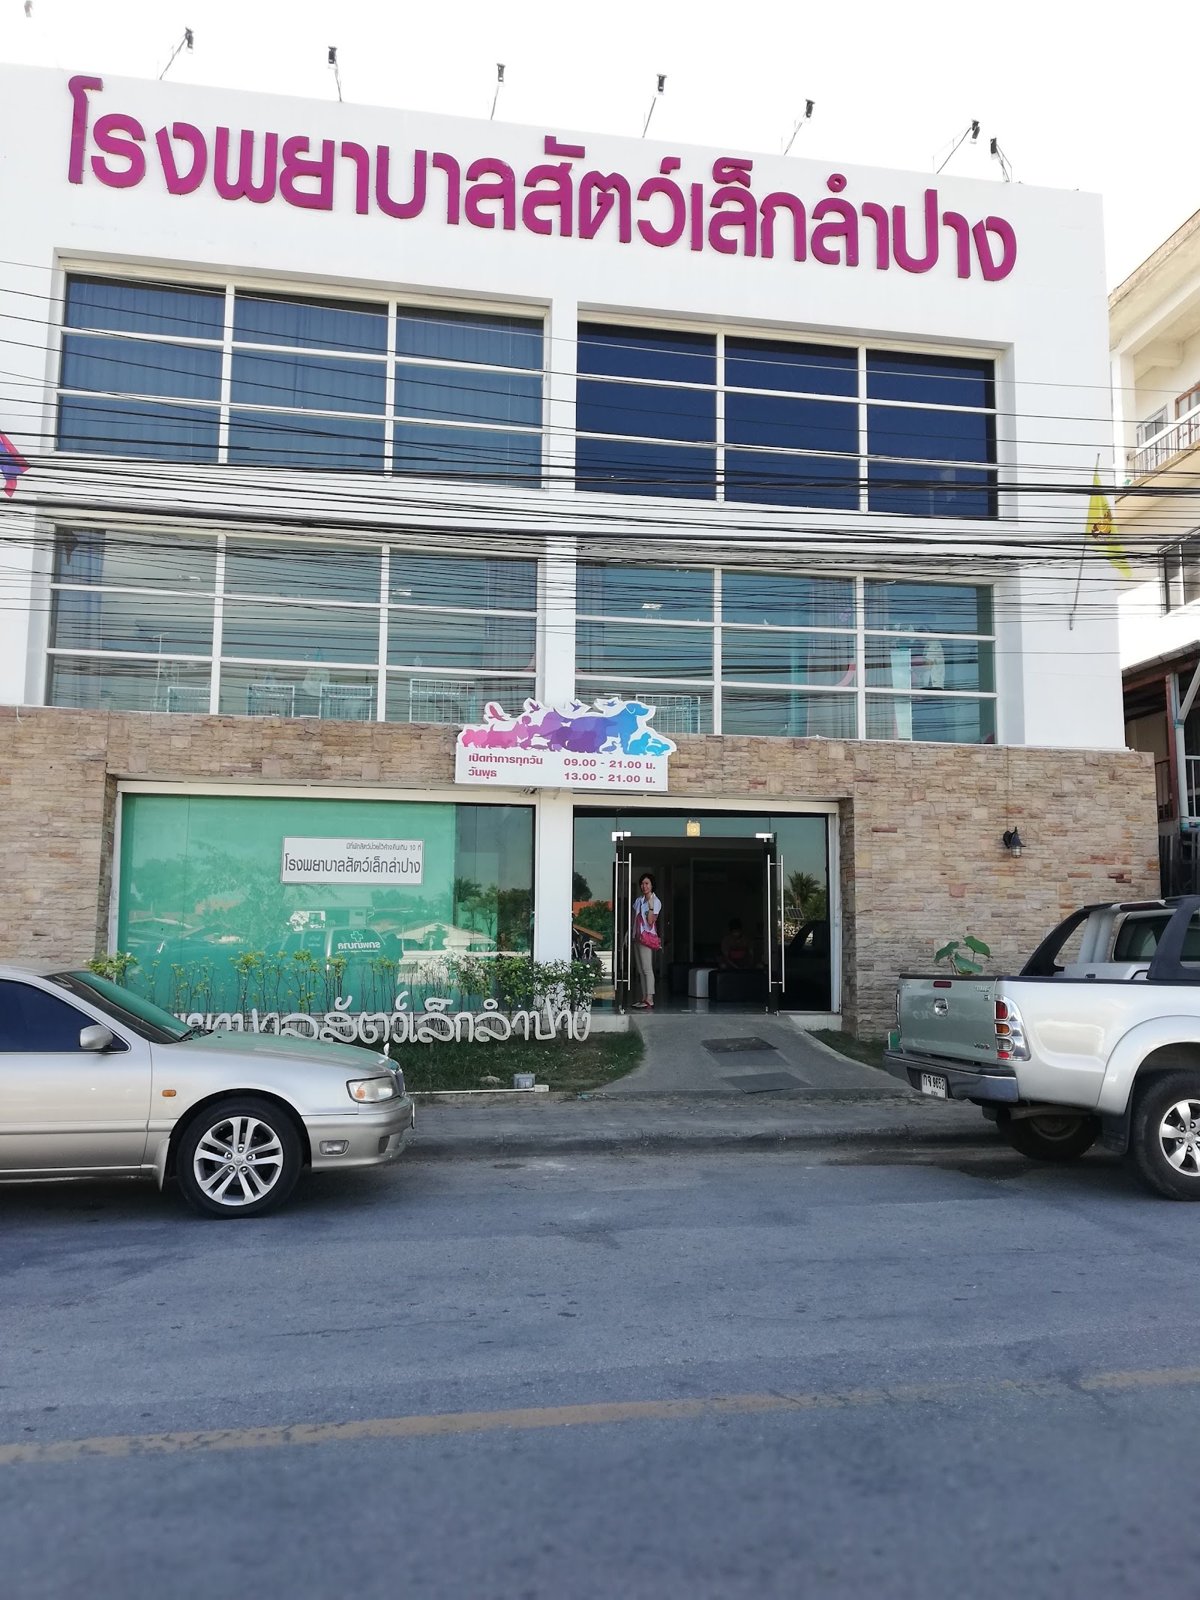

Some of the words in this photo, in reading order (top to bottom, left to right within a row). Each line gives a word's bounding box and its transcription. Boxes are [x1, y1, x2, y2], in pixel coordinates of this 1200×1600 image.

[70, 77, 1016, 281] โรงพยาบาลสัตว์เล็กลำปาง
[468, 753, 543, 766] เปิดทำการทุกวัน
[564, 758, 597, 767] 09.00
[609, 760, 641, 769] 21.00
[645, 762, 656, 770] น.
[468, 766, 497, 779] วันพุธ
[564, 772, 597, 781] 13.00
[608, 774, 641, 783] 21.00
[645, 776, 656, 784] น.
[285, 853, 421, 874] โรงพยาบาลสัตว์เล็กลำปาง
